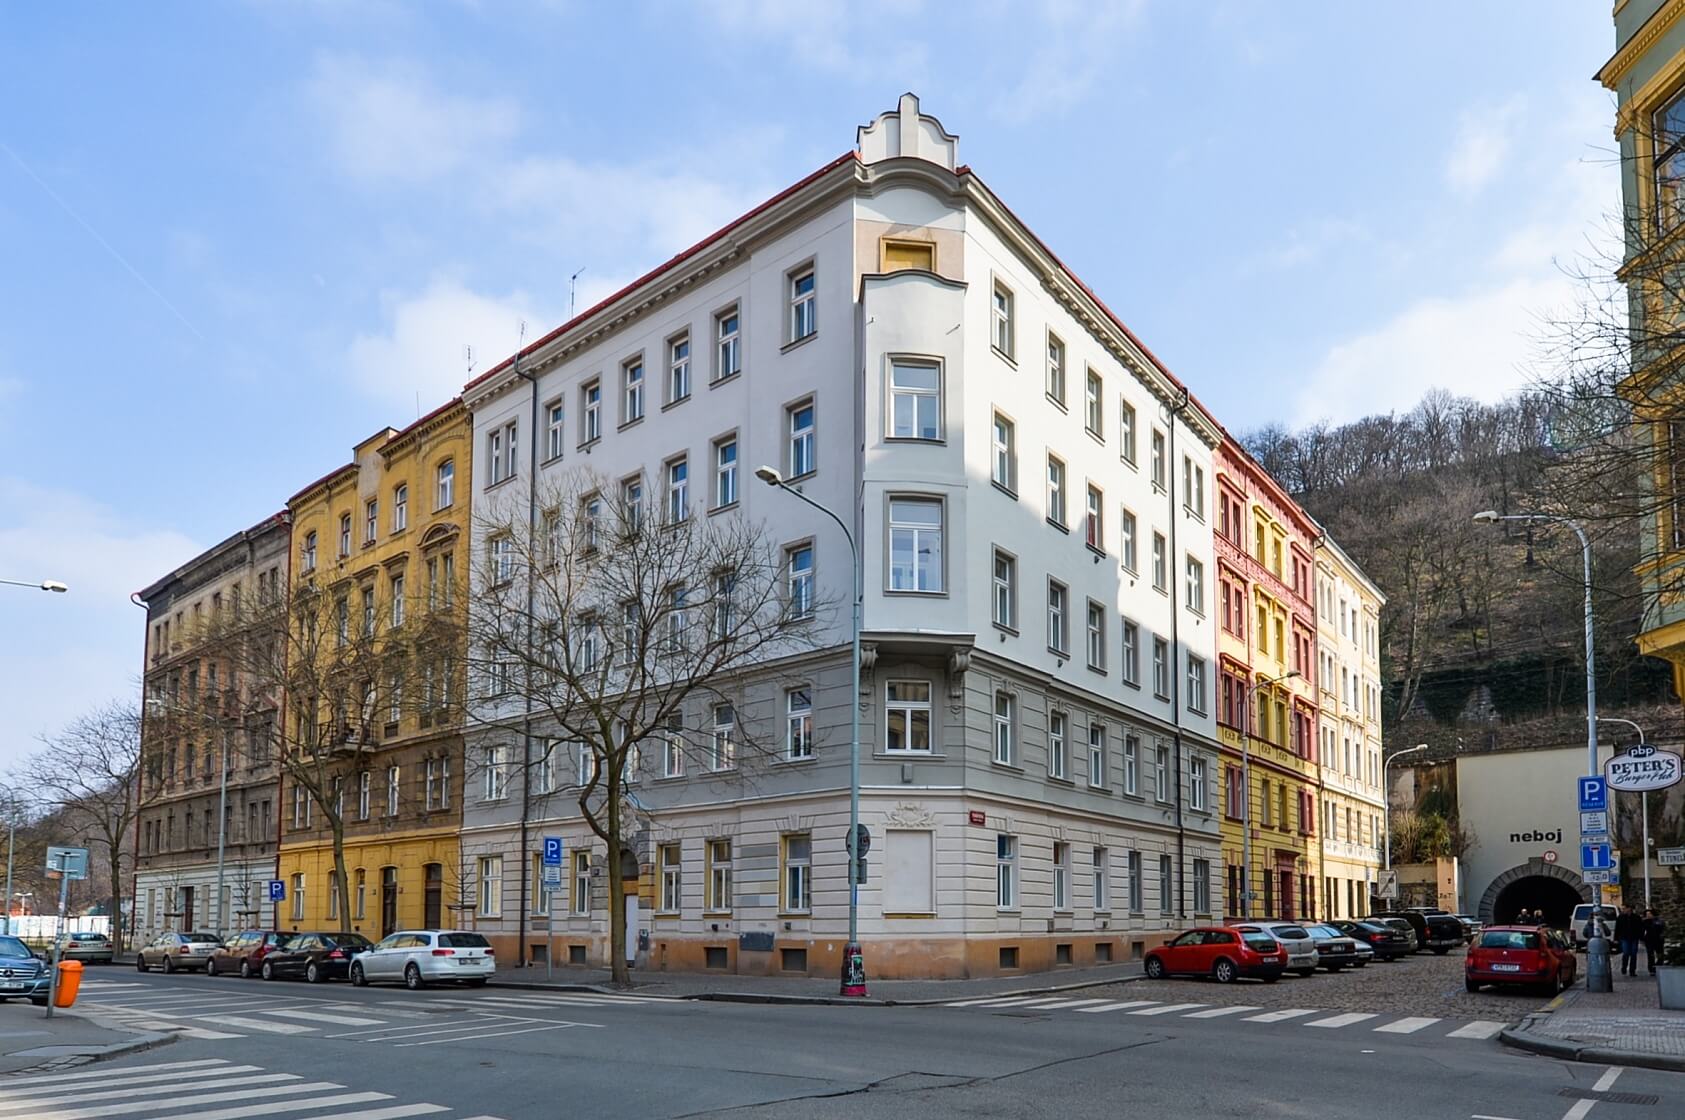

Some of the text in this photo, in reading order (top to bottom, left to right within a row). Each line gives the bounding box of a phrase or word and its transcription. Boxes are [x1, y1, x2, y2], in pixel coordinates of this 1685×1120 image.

[1630, 744, 1654, 758] pbp
[1611, 758, 1675, 774] PETER'S
[1584, 781, 1600, 801] P
[1510, 828, 1562, 844] neboj
[548, 841, 557, 856] P
[272, 883, 282, 895] P
